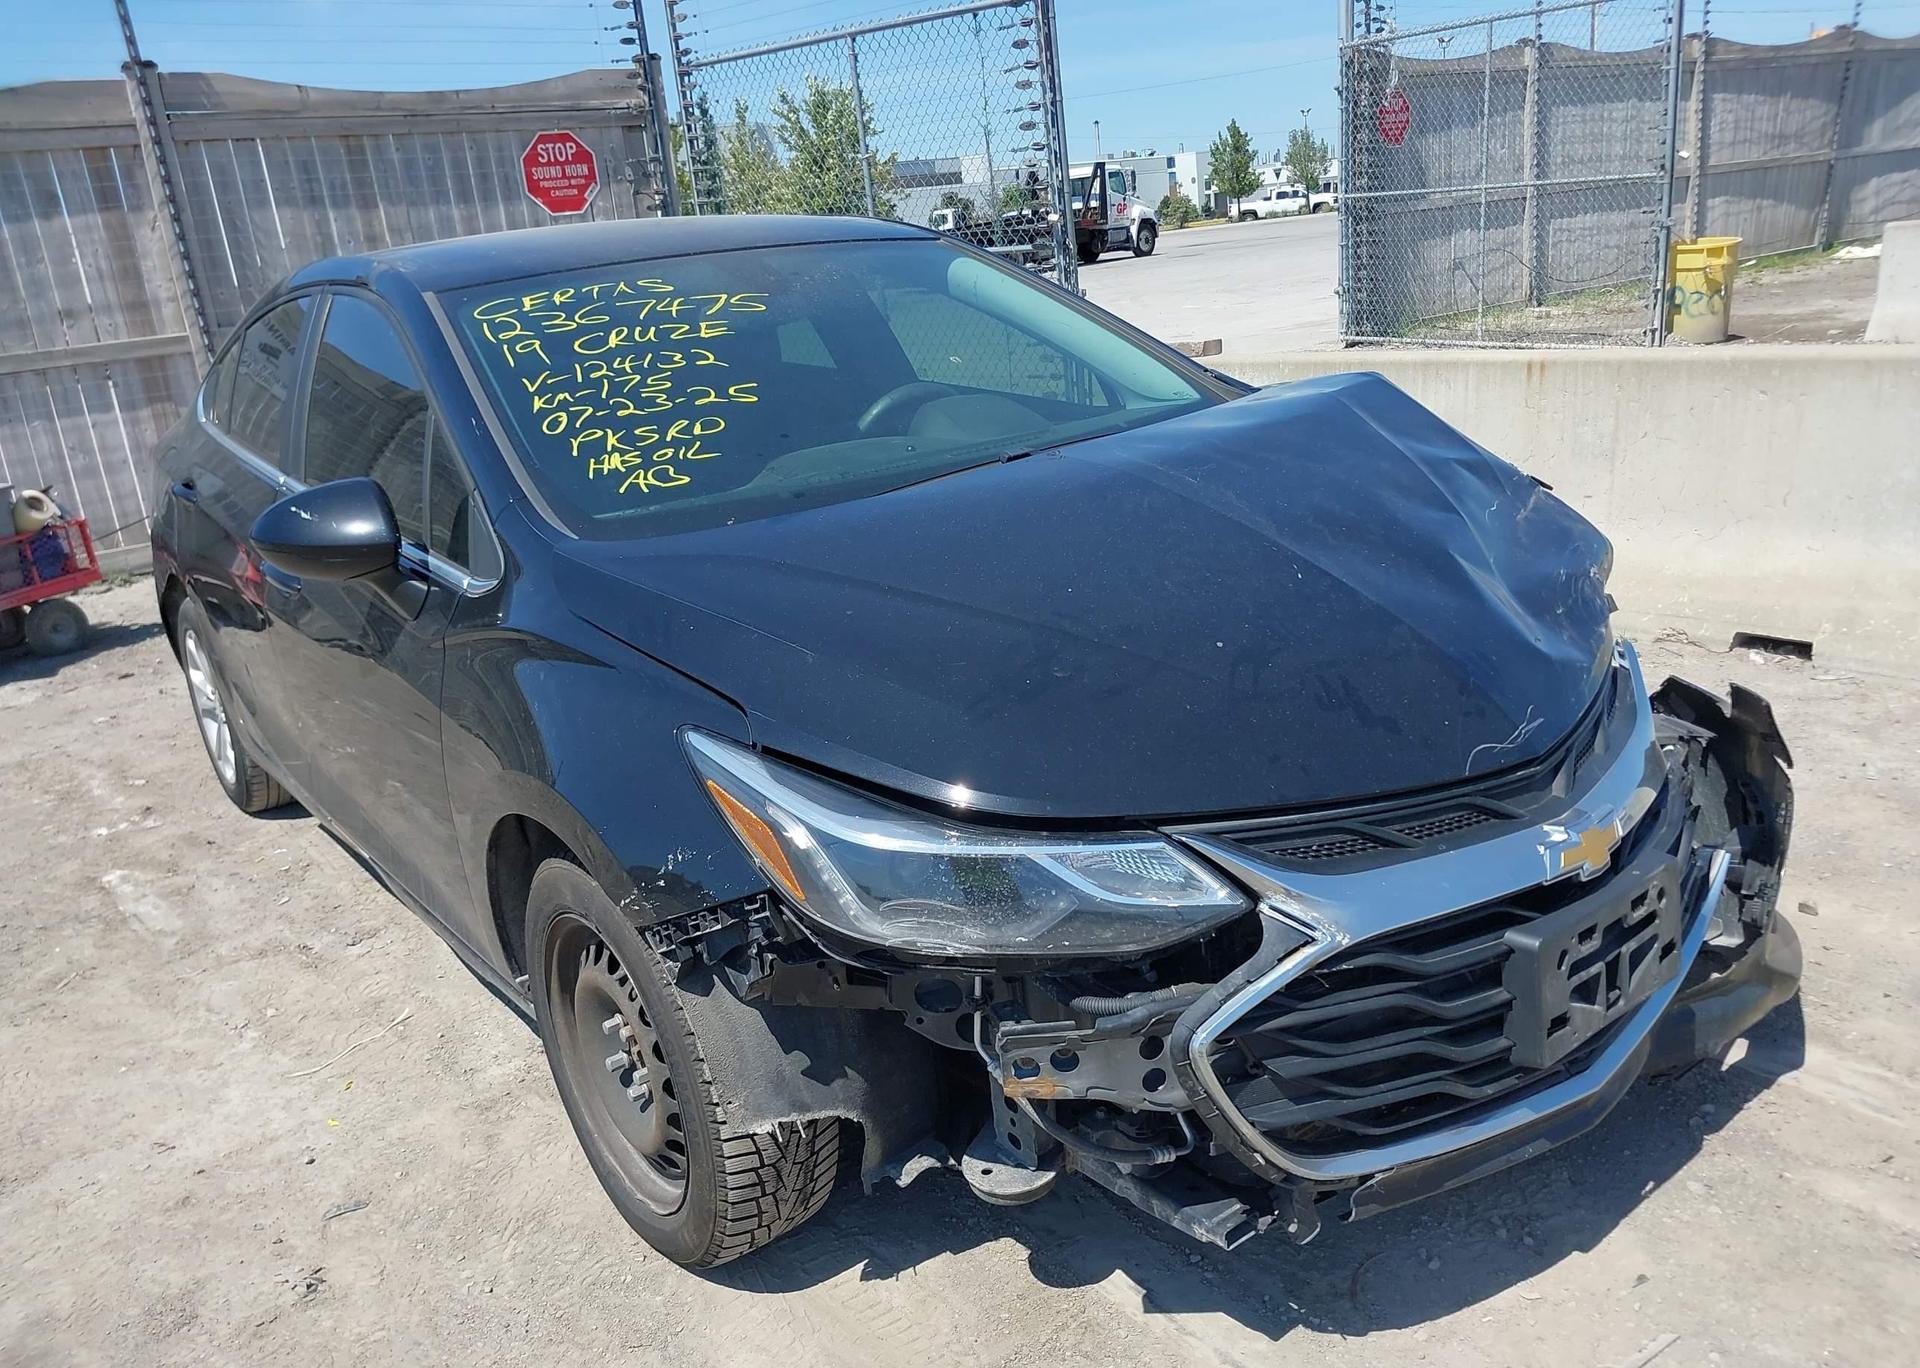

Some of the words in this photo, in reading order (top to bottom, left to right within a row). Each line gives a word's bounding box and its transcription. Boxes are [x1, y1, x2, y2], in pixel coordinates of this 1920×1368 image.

[537, 142, 577, 163] STOP
[531, 166, 562, 180] SOUND
[565, 164, 589, 177] HORN
[540, 179, 569, 188] PROCEED
[550, 188, 578, 197] CAUTION
[1116, 202, 1128, 214] GP
[474, 279, 674, 319] CERTAS
[503, 340, 551, 367] 19
[574, 321, 735, 354] CRUZE
[522, 350, 729, 392] V-124132
[542, 384, 758, 435] 07-23-25
[653, 441, 722, 460] OIL
